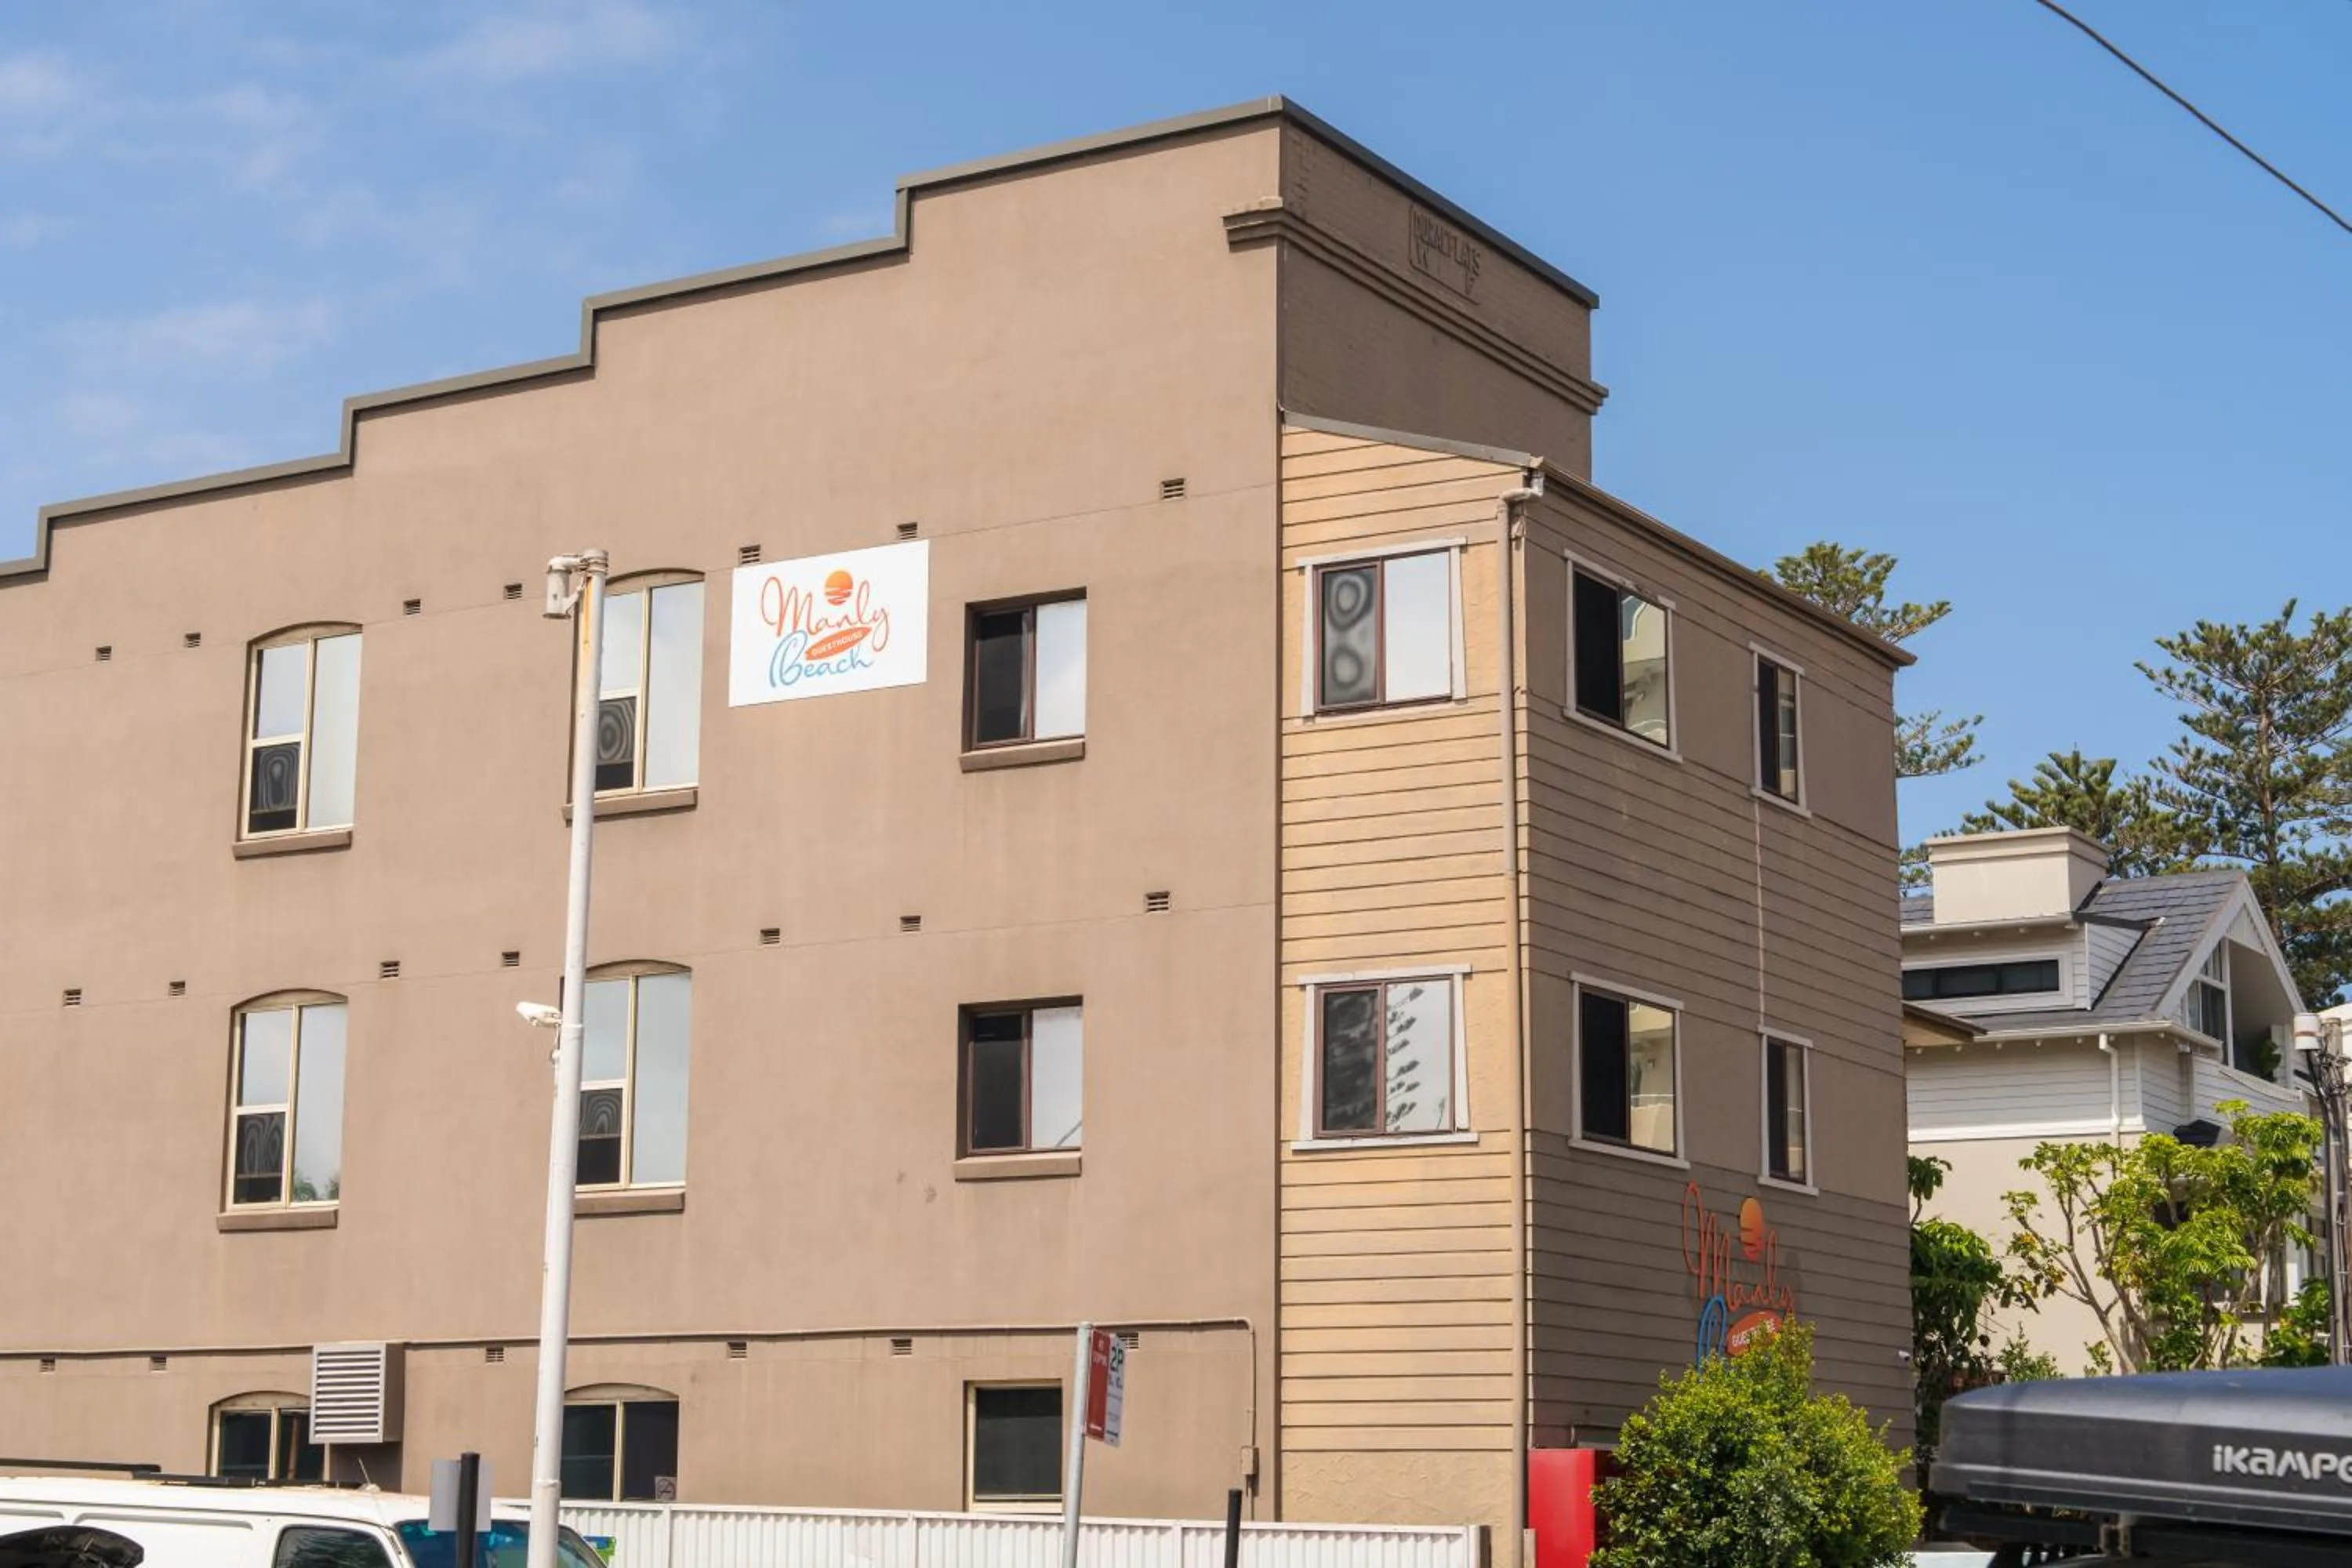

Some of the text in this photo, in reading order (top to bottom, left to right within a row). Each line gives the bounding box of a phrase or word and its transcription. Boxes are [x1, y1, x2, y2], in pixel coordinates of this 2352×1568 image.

[761, 576, 889, 652] Manly
[768, 630, 874, 688] Beach
[1110, 1345, 1124, 1373] 2P
